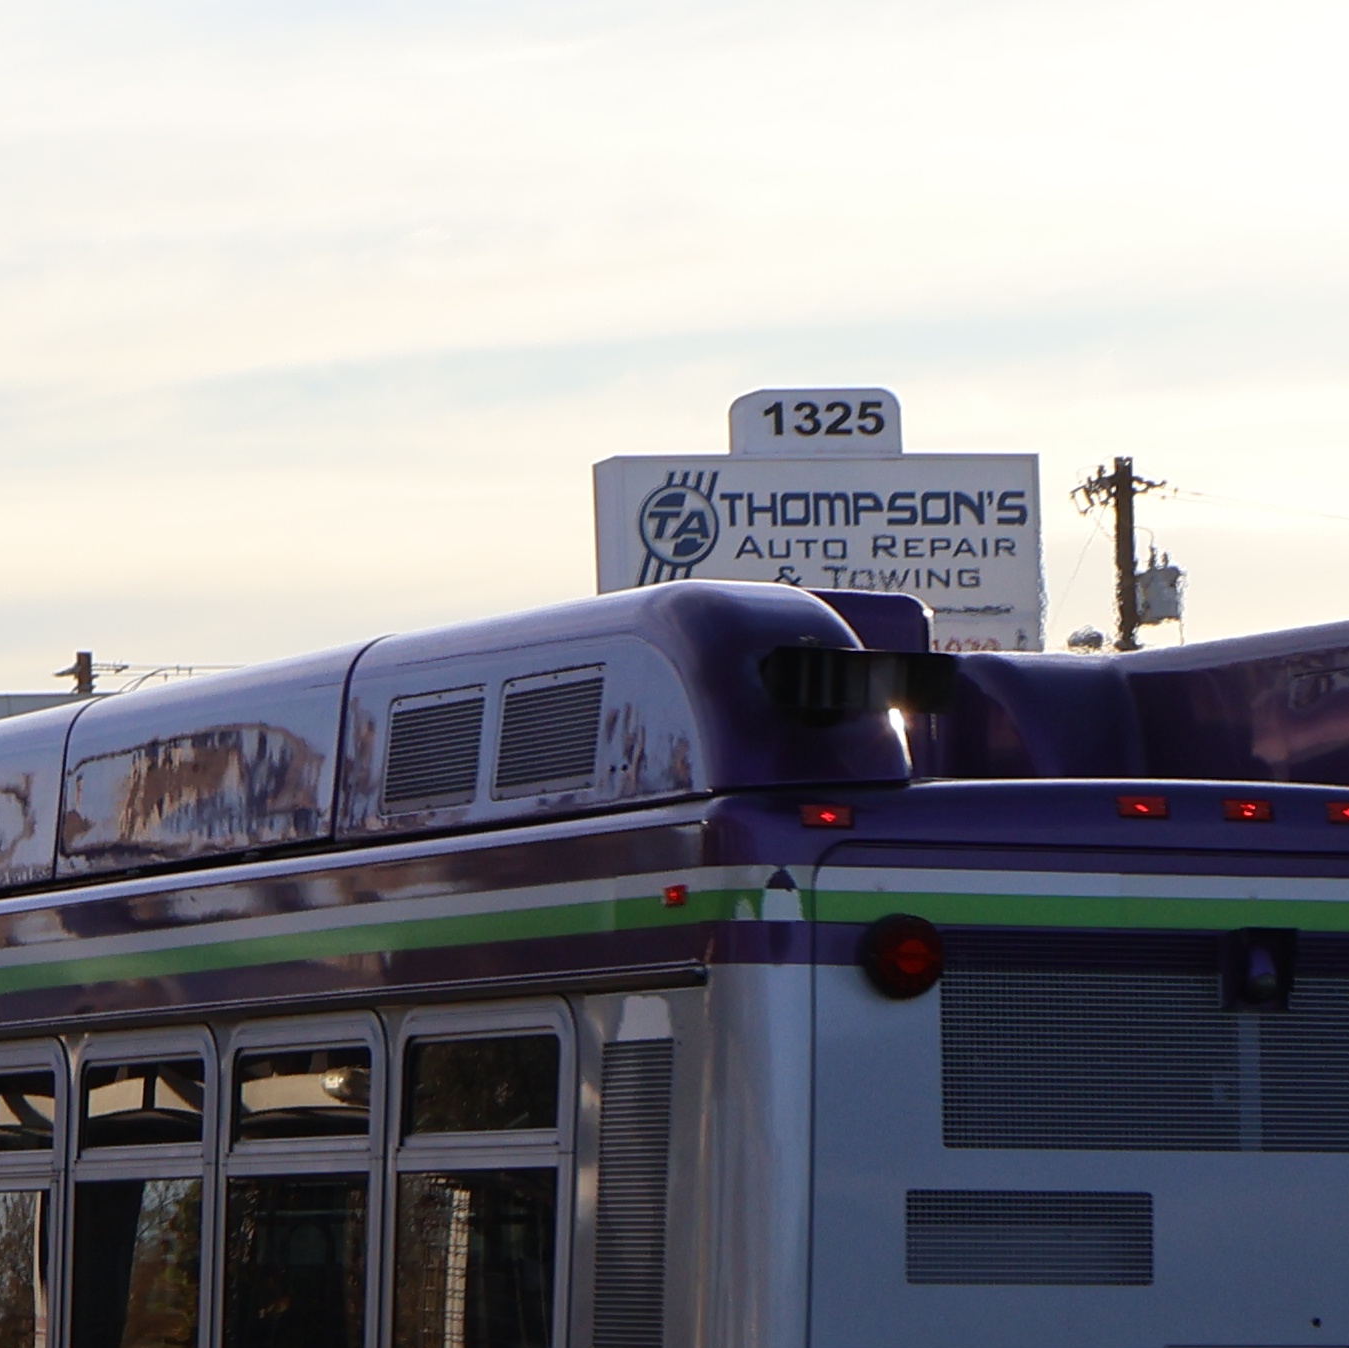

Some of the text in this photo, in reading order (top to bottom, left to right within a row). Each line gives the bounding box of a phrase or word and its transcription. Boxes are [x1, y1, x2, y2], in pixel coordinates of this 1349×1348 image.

[763, 401, 885, 436] 1325
[720, 490, 1028, 526] THOMPSON'S
[735, 534, 1018, 560] AUTO REPAIR
[773, 566, 982, 589] & TOWING
